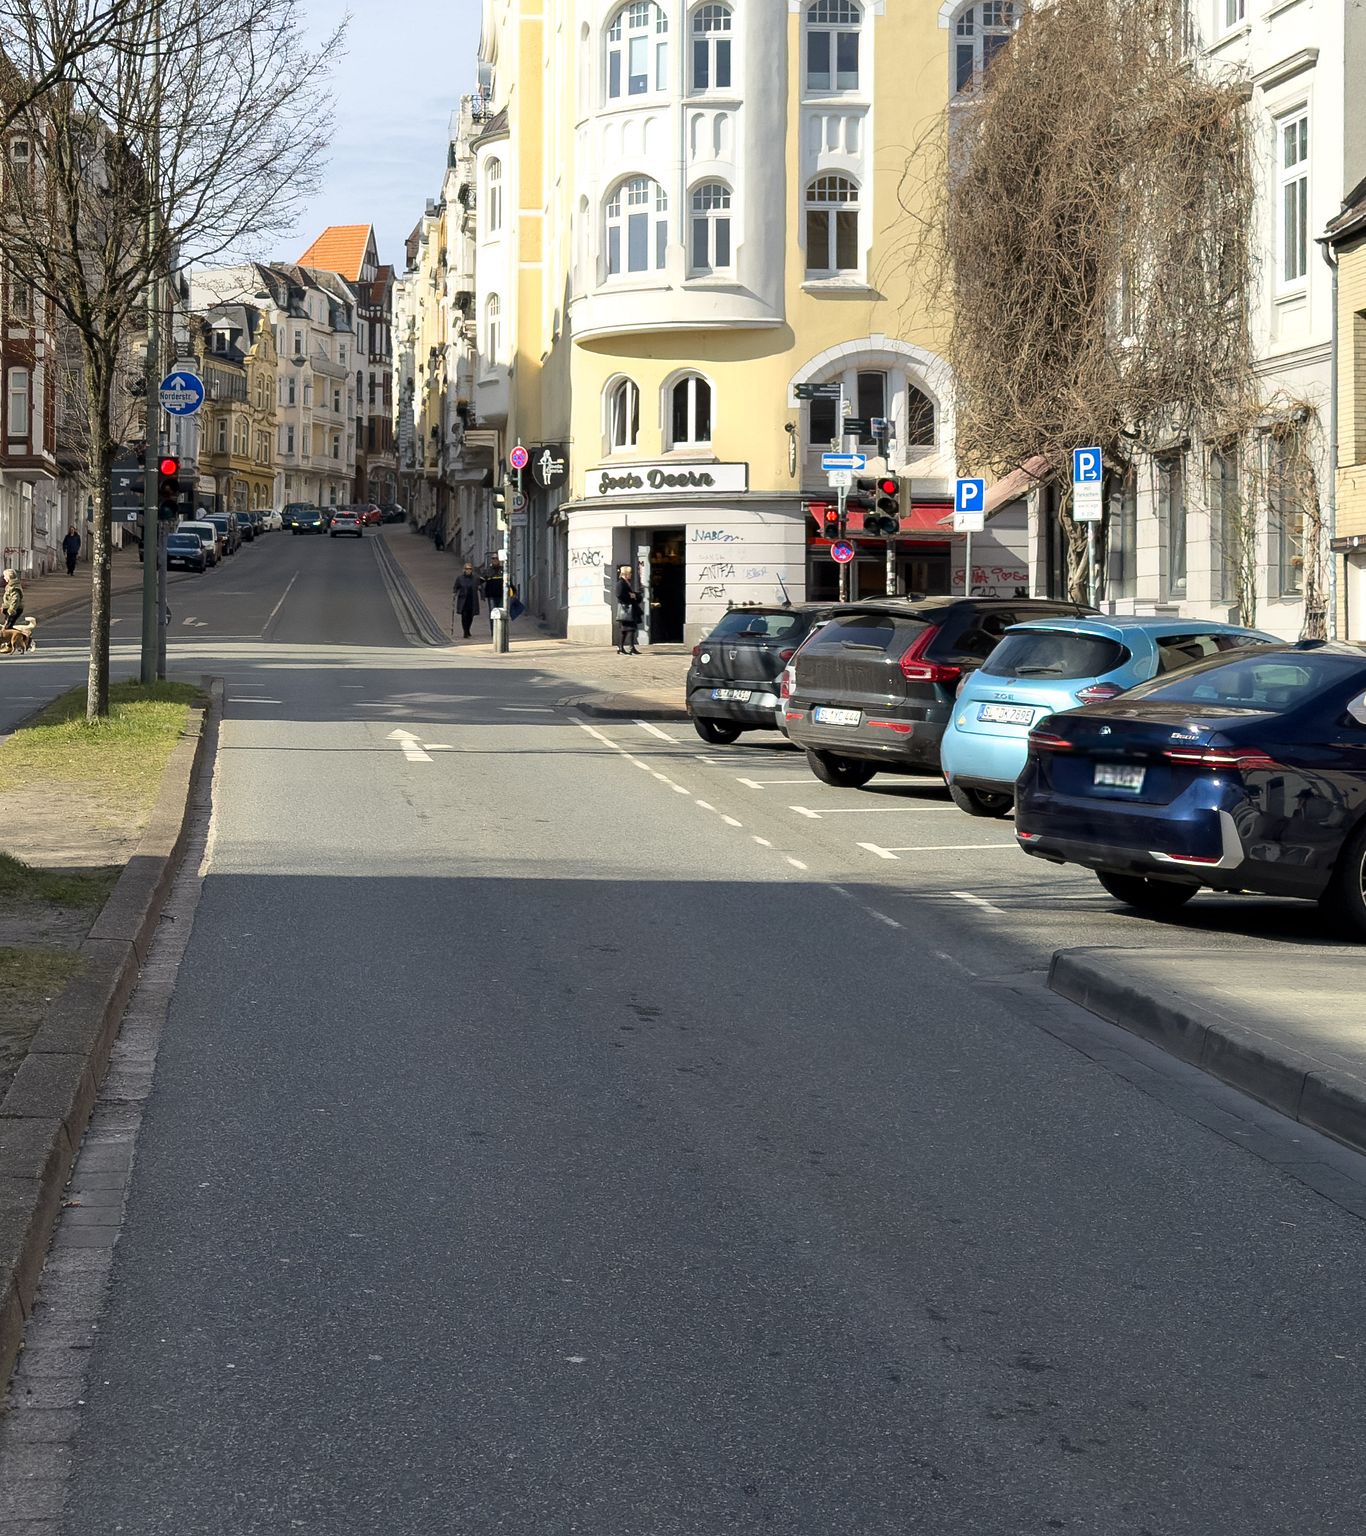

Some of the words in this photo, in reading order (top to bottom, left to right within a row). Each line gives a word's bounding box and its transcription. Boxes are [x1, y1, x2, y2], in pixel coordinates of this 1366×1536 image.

[160, 392, 193, 401] Norderstr.
[1080, 453, 1094, 481] P
[961, 483, 978, 509] P
[994, 692, 1015, 700] ZOE
